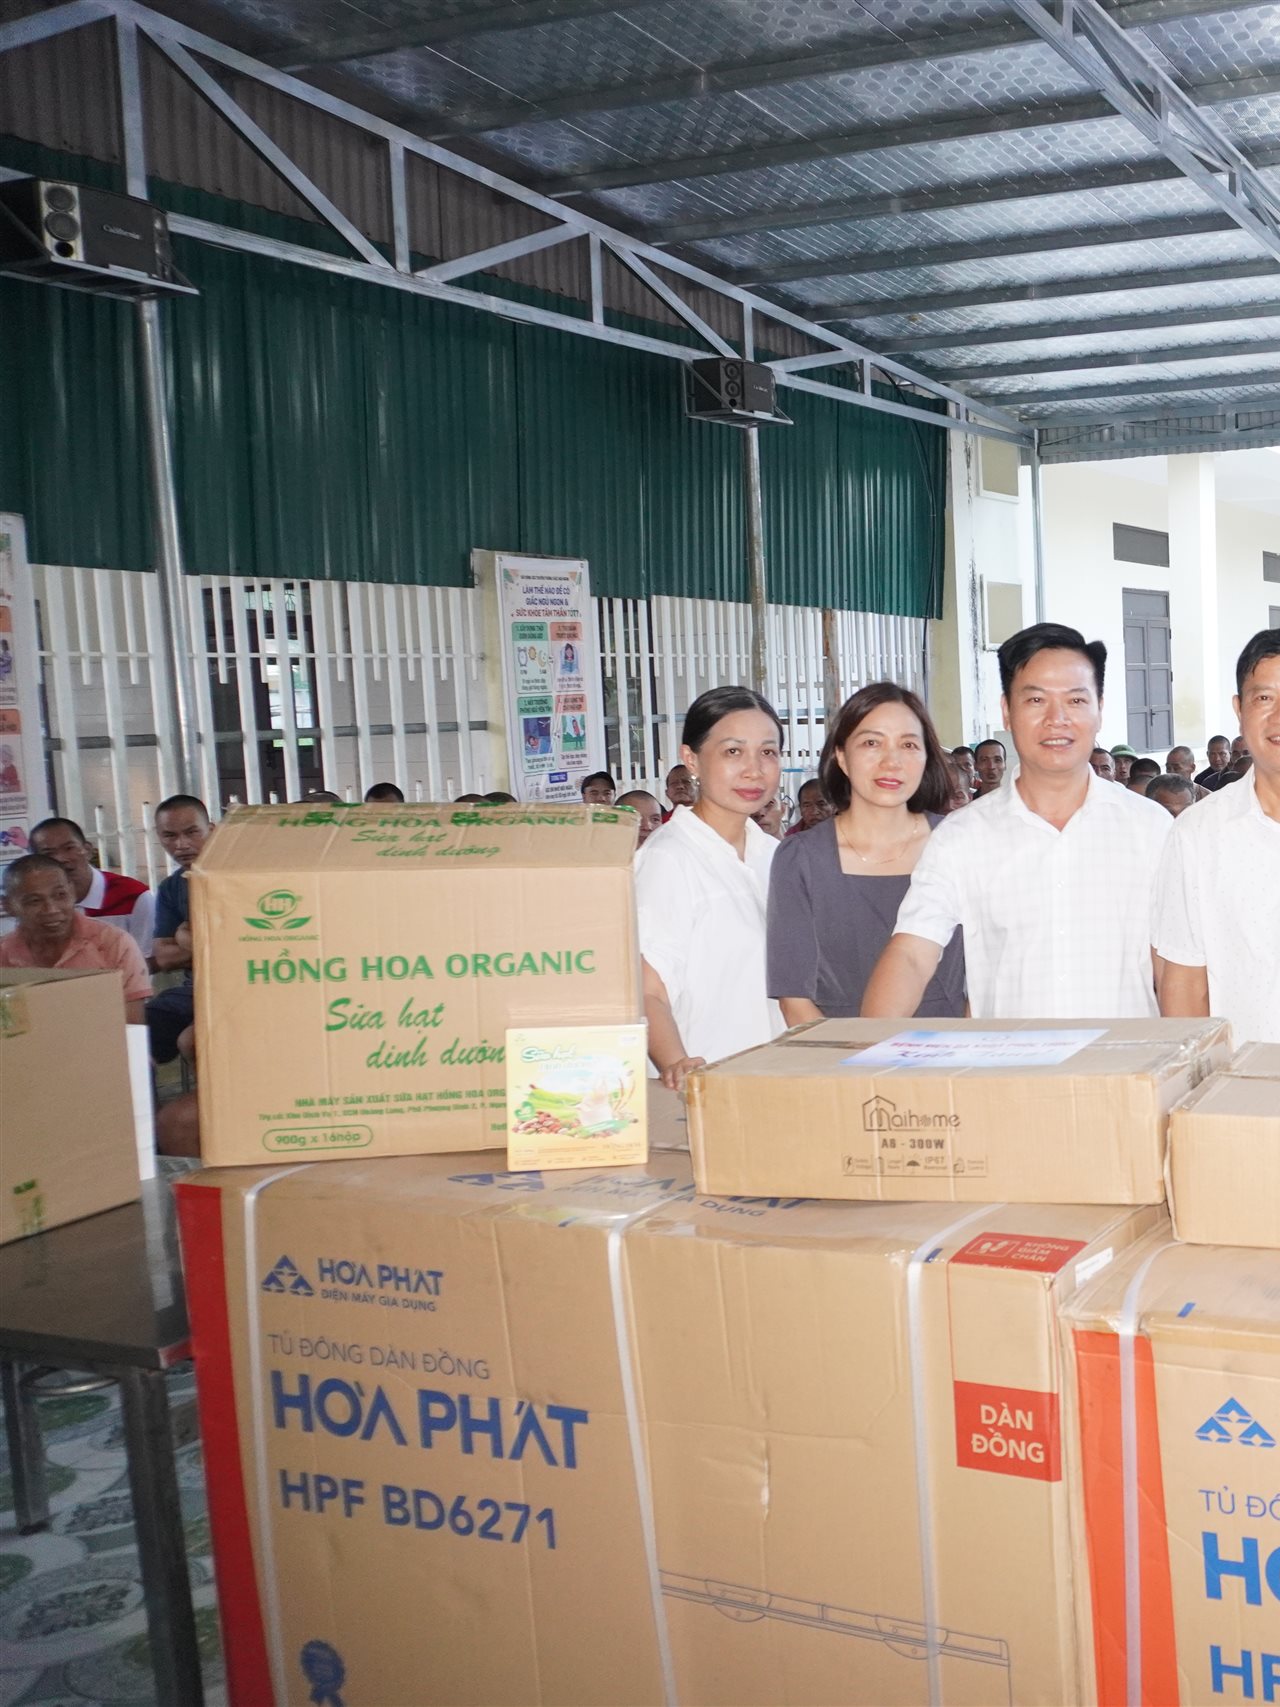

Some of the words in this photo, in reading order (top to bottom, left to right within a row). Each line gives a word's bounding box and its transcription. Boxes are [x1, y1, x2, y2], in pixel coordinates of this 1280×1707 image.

[378, 816, 441, 828] HOA
[247, 948, 348, 985] HỒNG
[361, 954, 434, 981] HOA
[446, 949, 597, 977] ORGANIC
[325, 997, 387, 1032] Sữa
[397, 997, 446, 1035] hạt
[366, 1039, 429, 1070] dinh
[440, 1037, 506, 1067] dưỡn
[275, 1135, 306, 1147] 900g
[909, 1138, 945, 1149] 300W
[699, 1199, 768, 1217] DỤNG
[377, 1263, 445, 1296] PHÁT
[320, 1287, 348, 1302] ĐIỆN
[350, 1291, 375, 1306] MÁY
[378, 1295, 400, 1308] GIA
[401, 1297, 437, 1314] DỤNG
[268, 1329, 293, 1355] TỦ
[299, 1334, 363, 1365] ĐÔNG
[369, 1343, 416, 1371] DÀN
[422, 1347, 491, 1380] ĐỒNG
[270, 1369, 408, 1447] HÒA
[416, 1387, 590, 1470] PHÁT
[980, 1403, 1034, 1432] DÀN
[970, 1430, 1045, 1465] ĐỒNG
[278, 1468, 366, 1519] HPF
[381, 1483, 558, 1551] BD6271
[1198, 1484, 1236, 1516] TỦ
